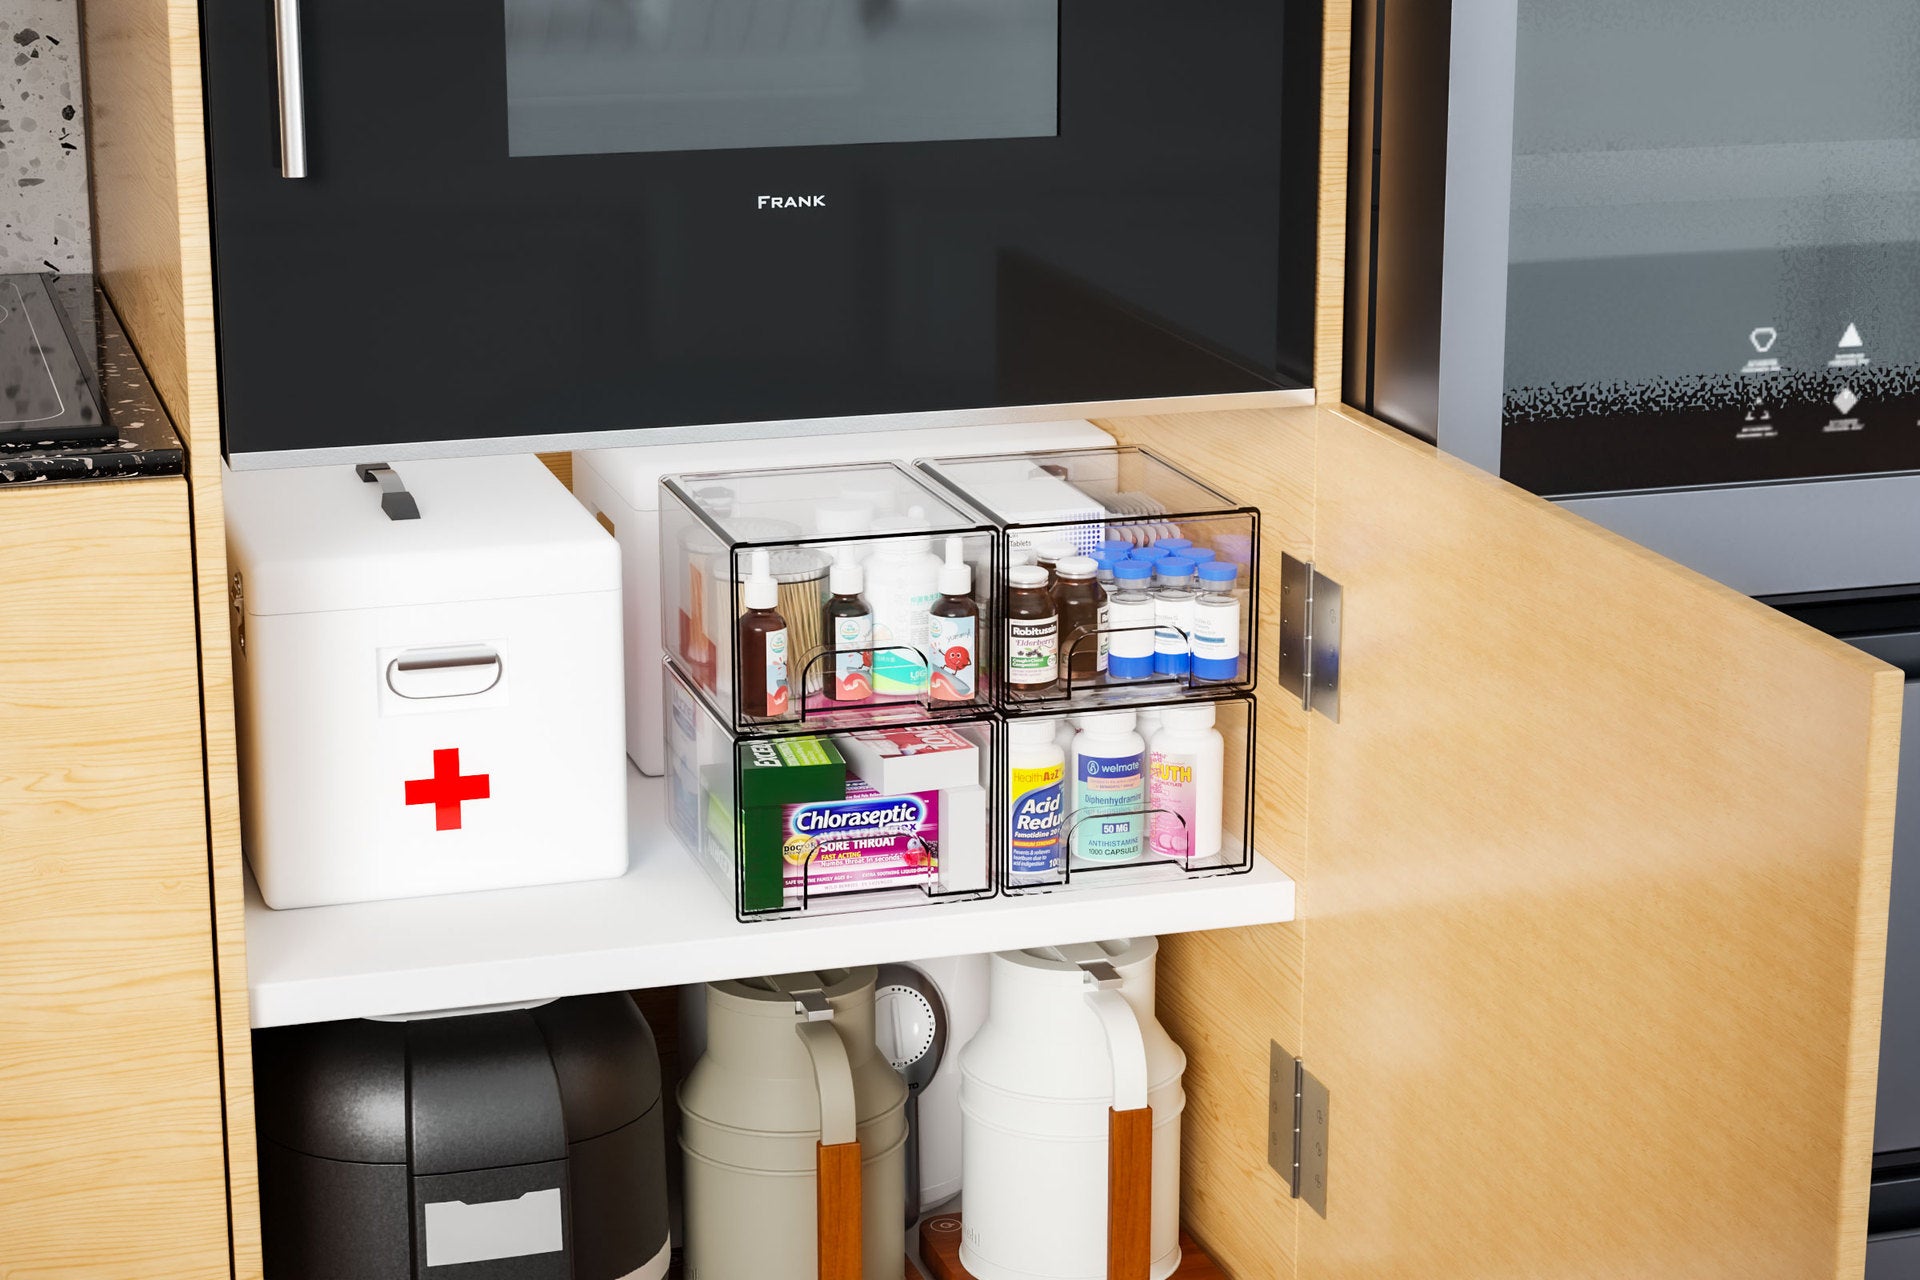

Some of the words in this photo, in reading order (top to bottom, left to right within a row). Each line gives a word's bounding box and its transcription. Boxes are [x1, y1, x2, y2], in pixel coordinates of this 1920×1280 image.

[758, 195, 826, 209] FRANK
[1101, 761, 1139, 773] welmate
[1021, 793, 1061, 814] Acid
[796, 803, 916, 831] Chloraseptic
[1103, 824, 1115, 833] 50
[1115, 823, 1128, 832] MG
[820, 840, 850, 853] SORE
[853, 836, 897, 850] THROAT
[1088, 837, 1139, 847] ANTIHISTAMINE
[838, 851, 862, 860] ACTING
[1104, 845, 1139, 856] CAPSULES
